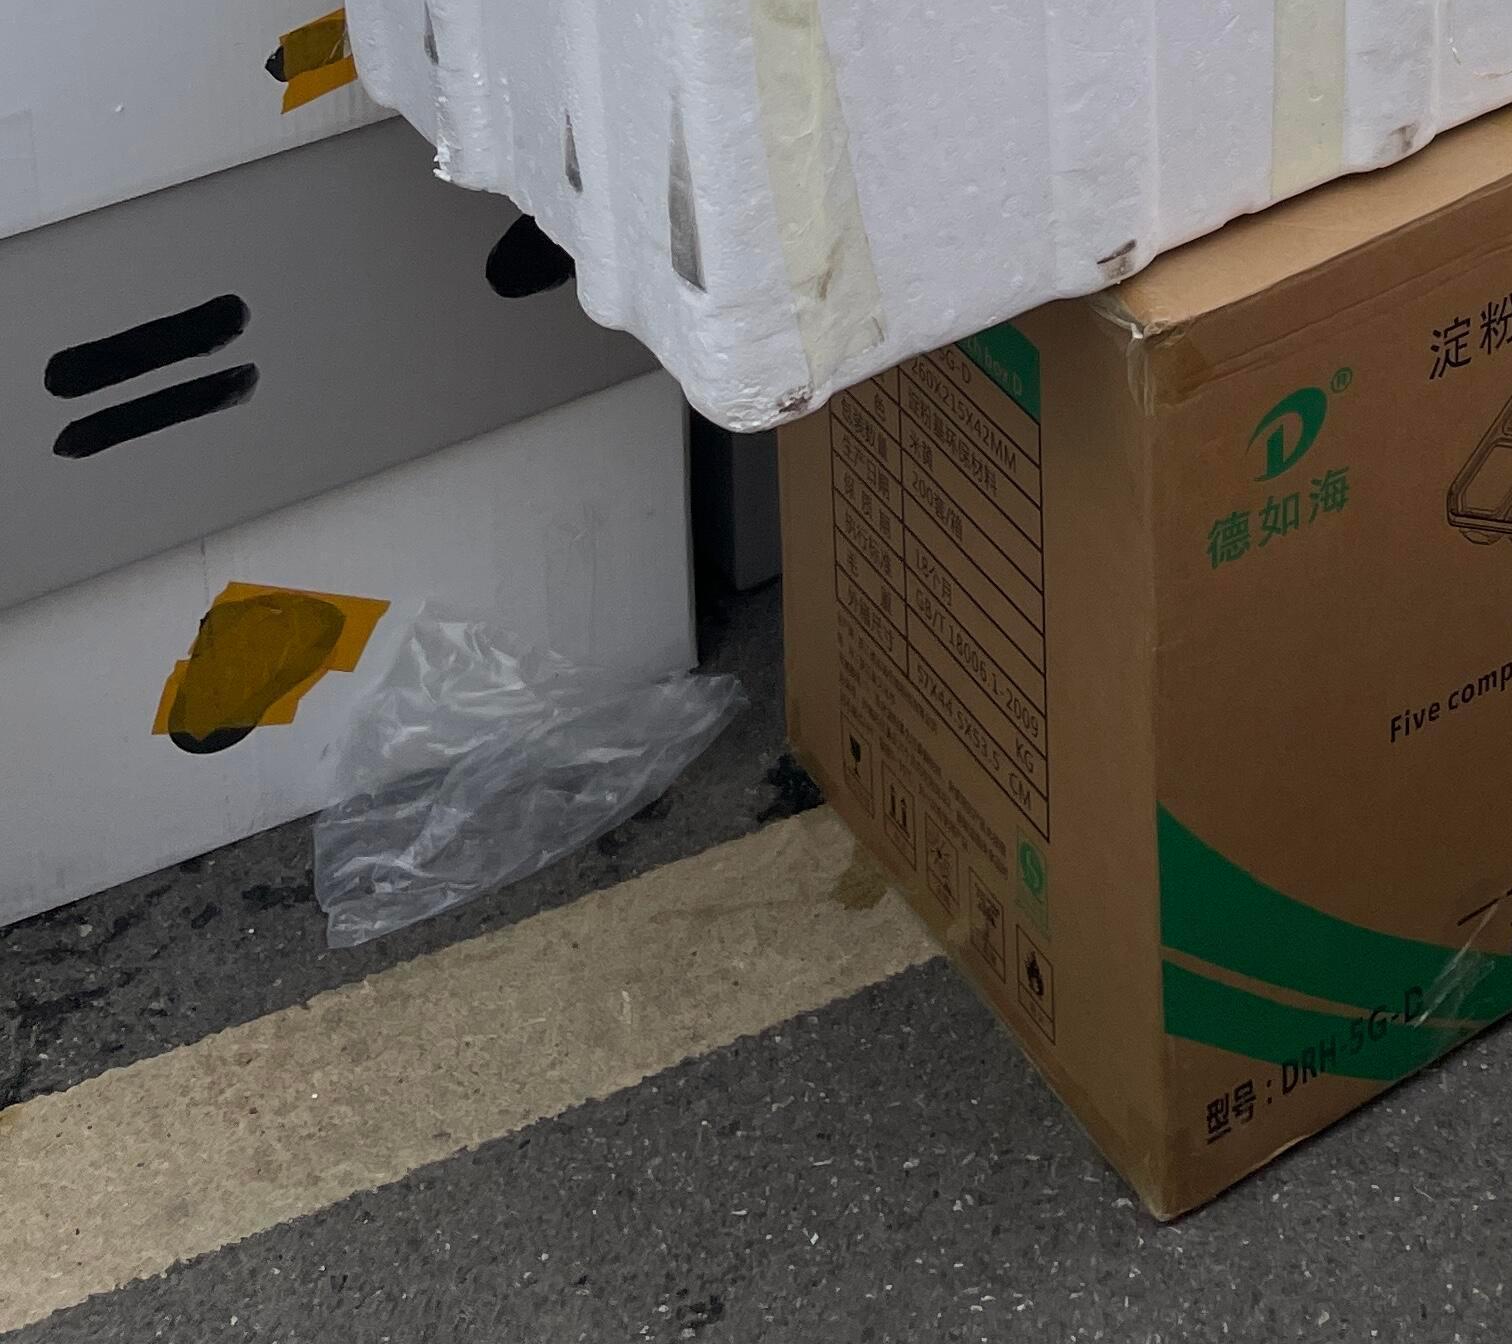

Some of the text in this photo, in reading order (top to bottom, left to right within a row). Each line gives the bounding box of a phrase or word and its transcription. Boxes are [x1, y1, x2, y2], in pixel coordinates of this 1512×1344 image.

[1206, 465, 1351, 570] 德如海
[1389, 698, 1441, 744] Five
[1015, 735, 1034, 776] KG
[1008, 767, 1031, 813] CM
